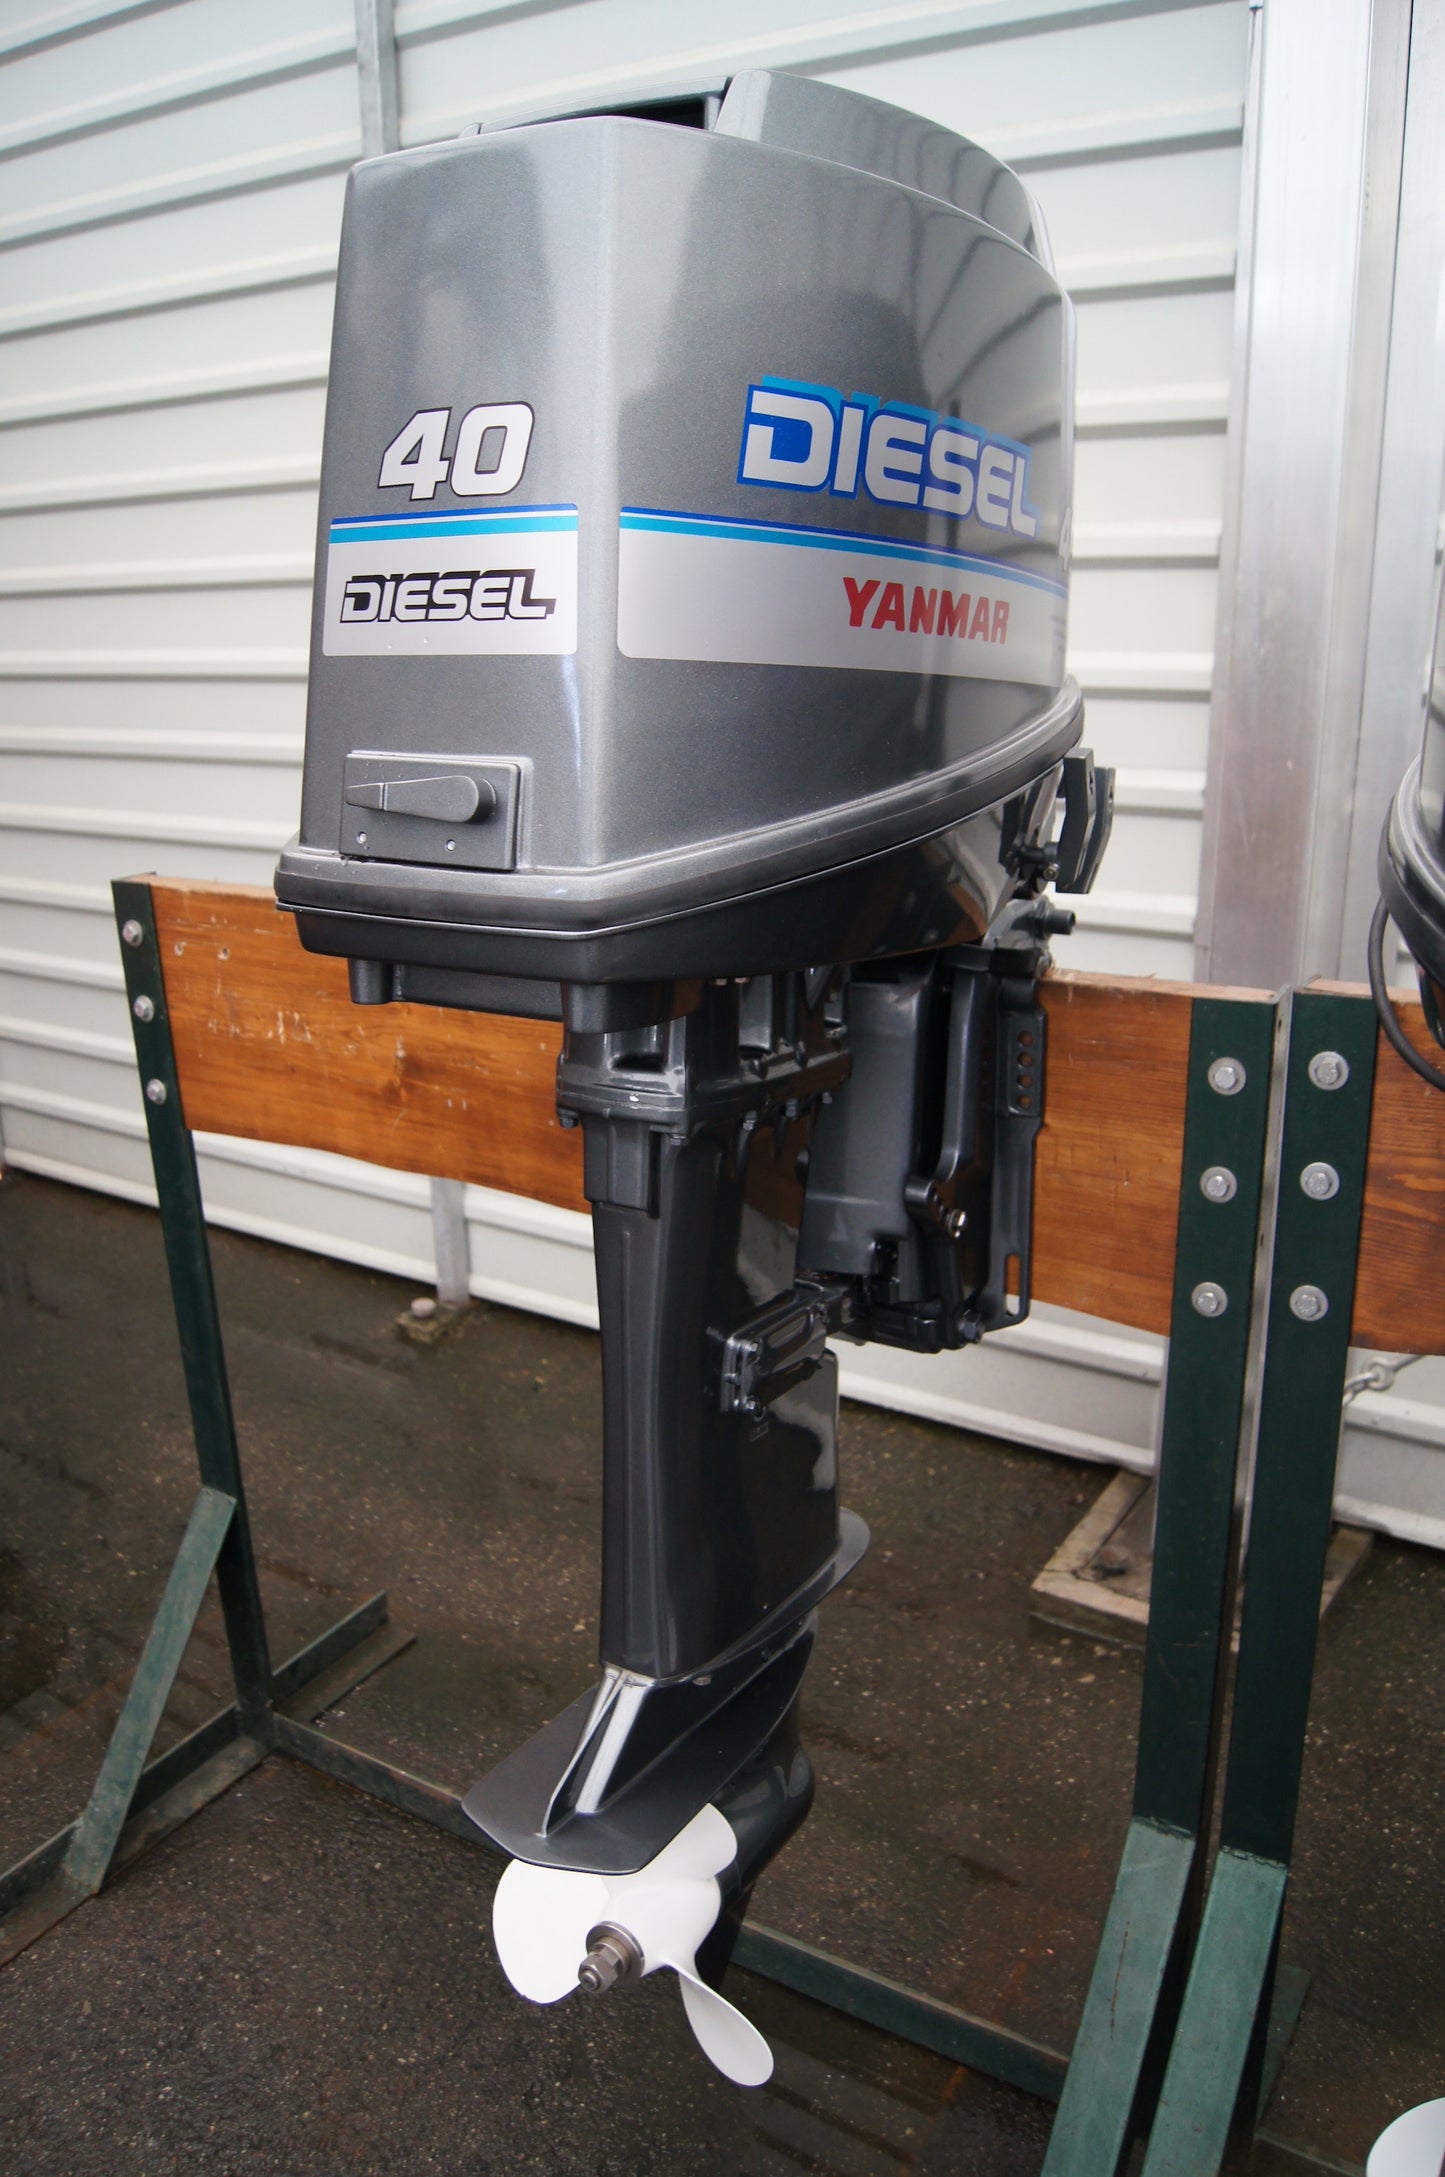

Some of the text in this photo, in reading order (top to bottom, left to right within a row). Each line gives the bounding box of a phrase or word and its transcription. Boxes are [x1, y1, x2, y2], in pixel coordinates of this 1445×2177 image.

[377, 400, 534, 501] 40
[737, 376, 1041, 541] DIESEL
[340, 569, 557, 623] DIESEL
[843, 577, 1010, 645] YANMAR
